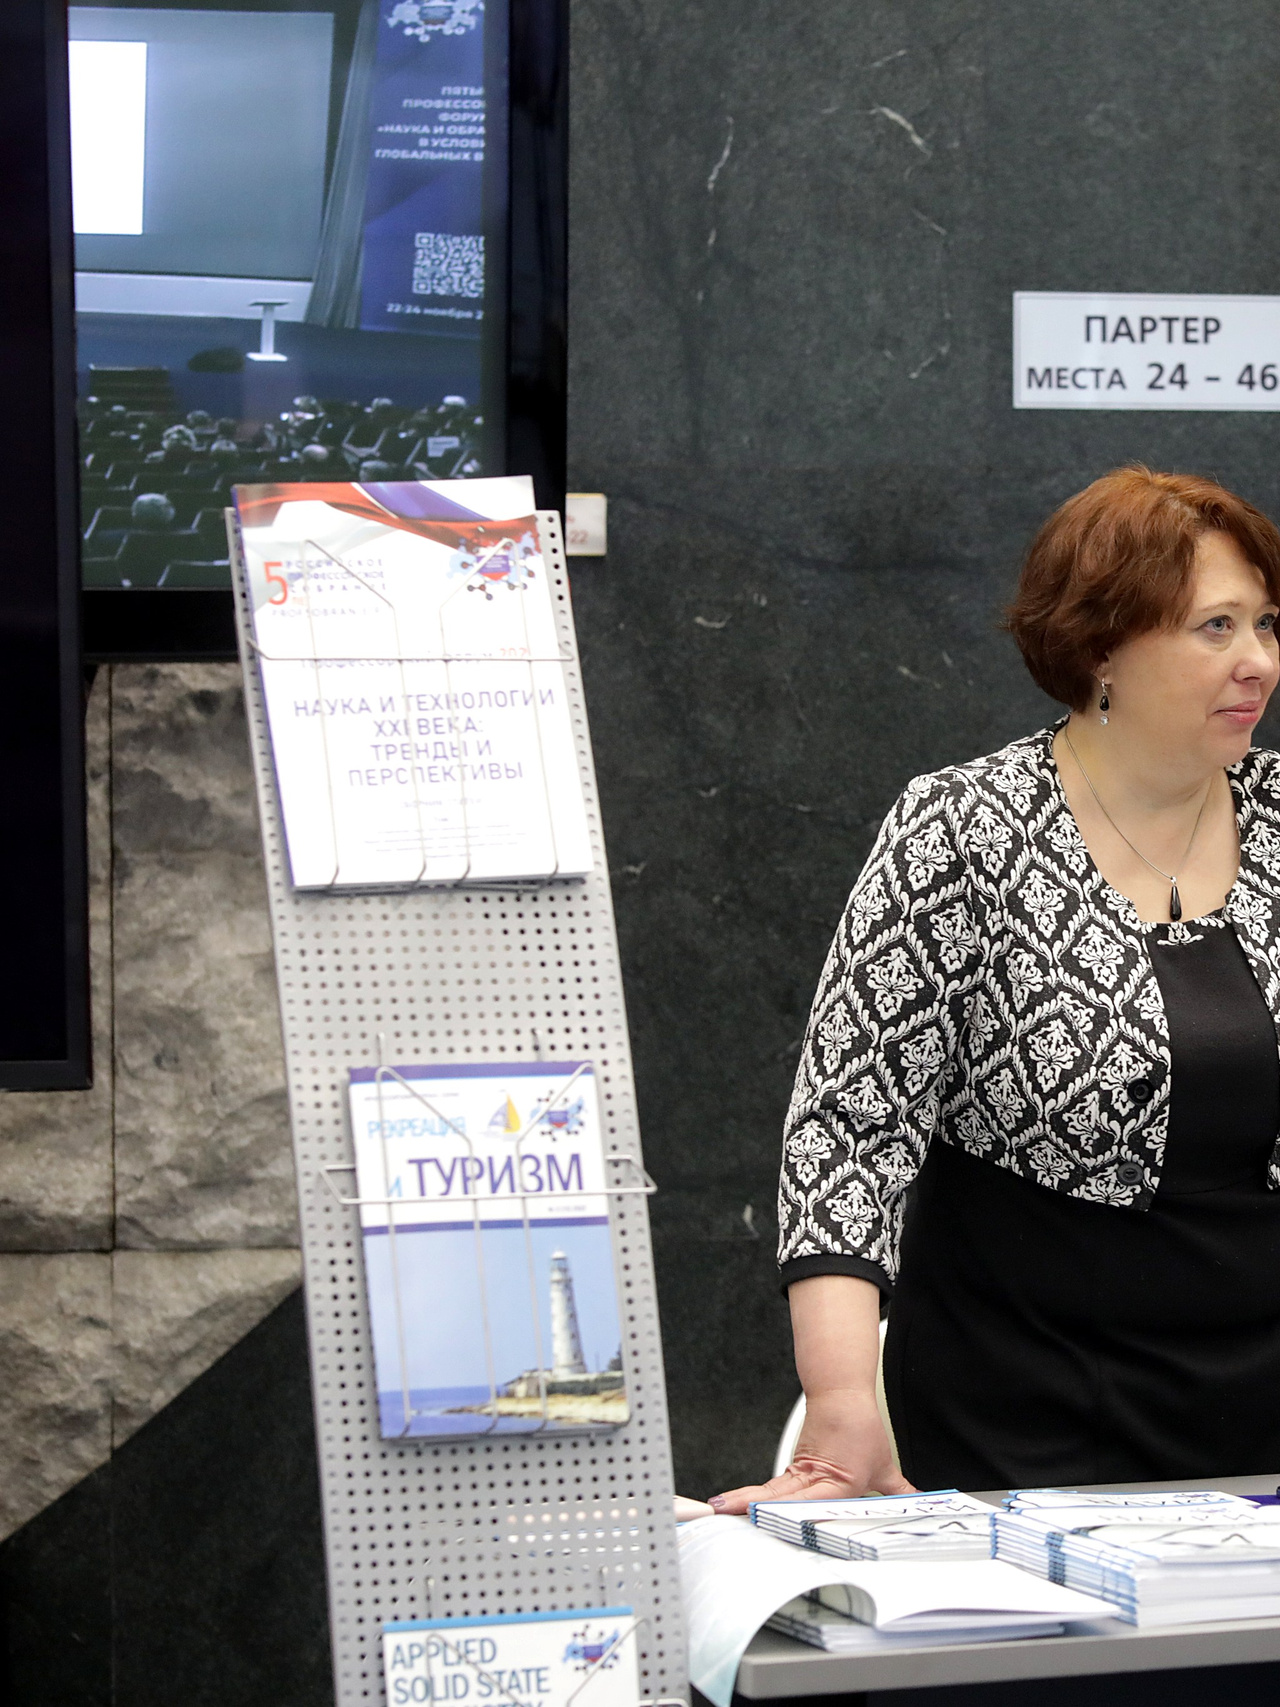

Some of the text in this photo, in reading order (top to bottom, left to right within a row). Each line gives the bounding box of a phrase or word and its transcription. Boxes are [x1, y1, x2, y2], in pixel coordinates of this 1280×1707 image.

[402, 98, 485, 109] ПРОФЕССО
[432, 125, 444, 135] И
[1085, 315, 1221, 345] ПАРТЕР
[1027, 367, 1127, 390] МЕСТА
[1146, 363, 1188, 390] 24
[1236, 363, 1278, 391] 46
[263, 561, 288, 605] 5
[293, 689, 555, 717] НАУКА И ТЕХНОЛОГИИ
[370, 740, 493, 761] ТРЕНДЫ И
[348, 762, 524, 786] ПЕРСПЕКТИВЫ
[407, 1153, 583, 1197] ТУРИЗМ
[391, 1637, 497, 1670] APPLIED
[393, 1666, 551, 1705] SOLID STATE
